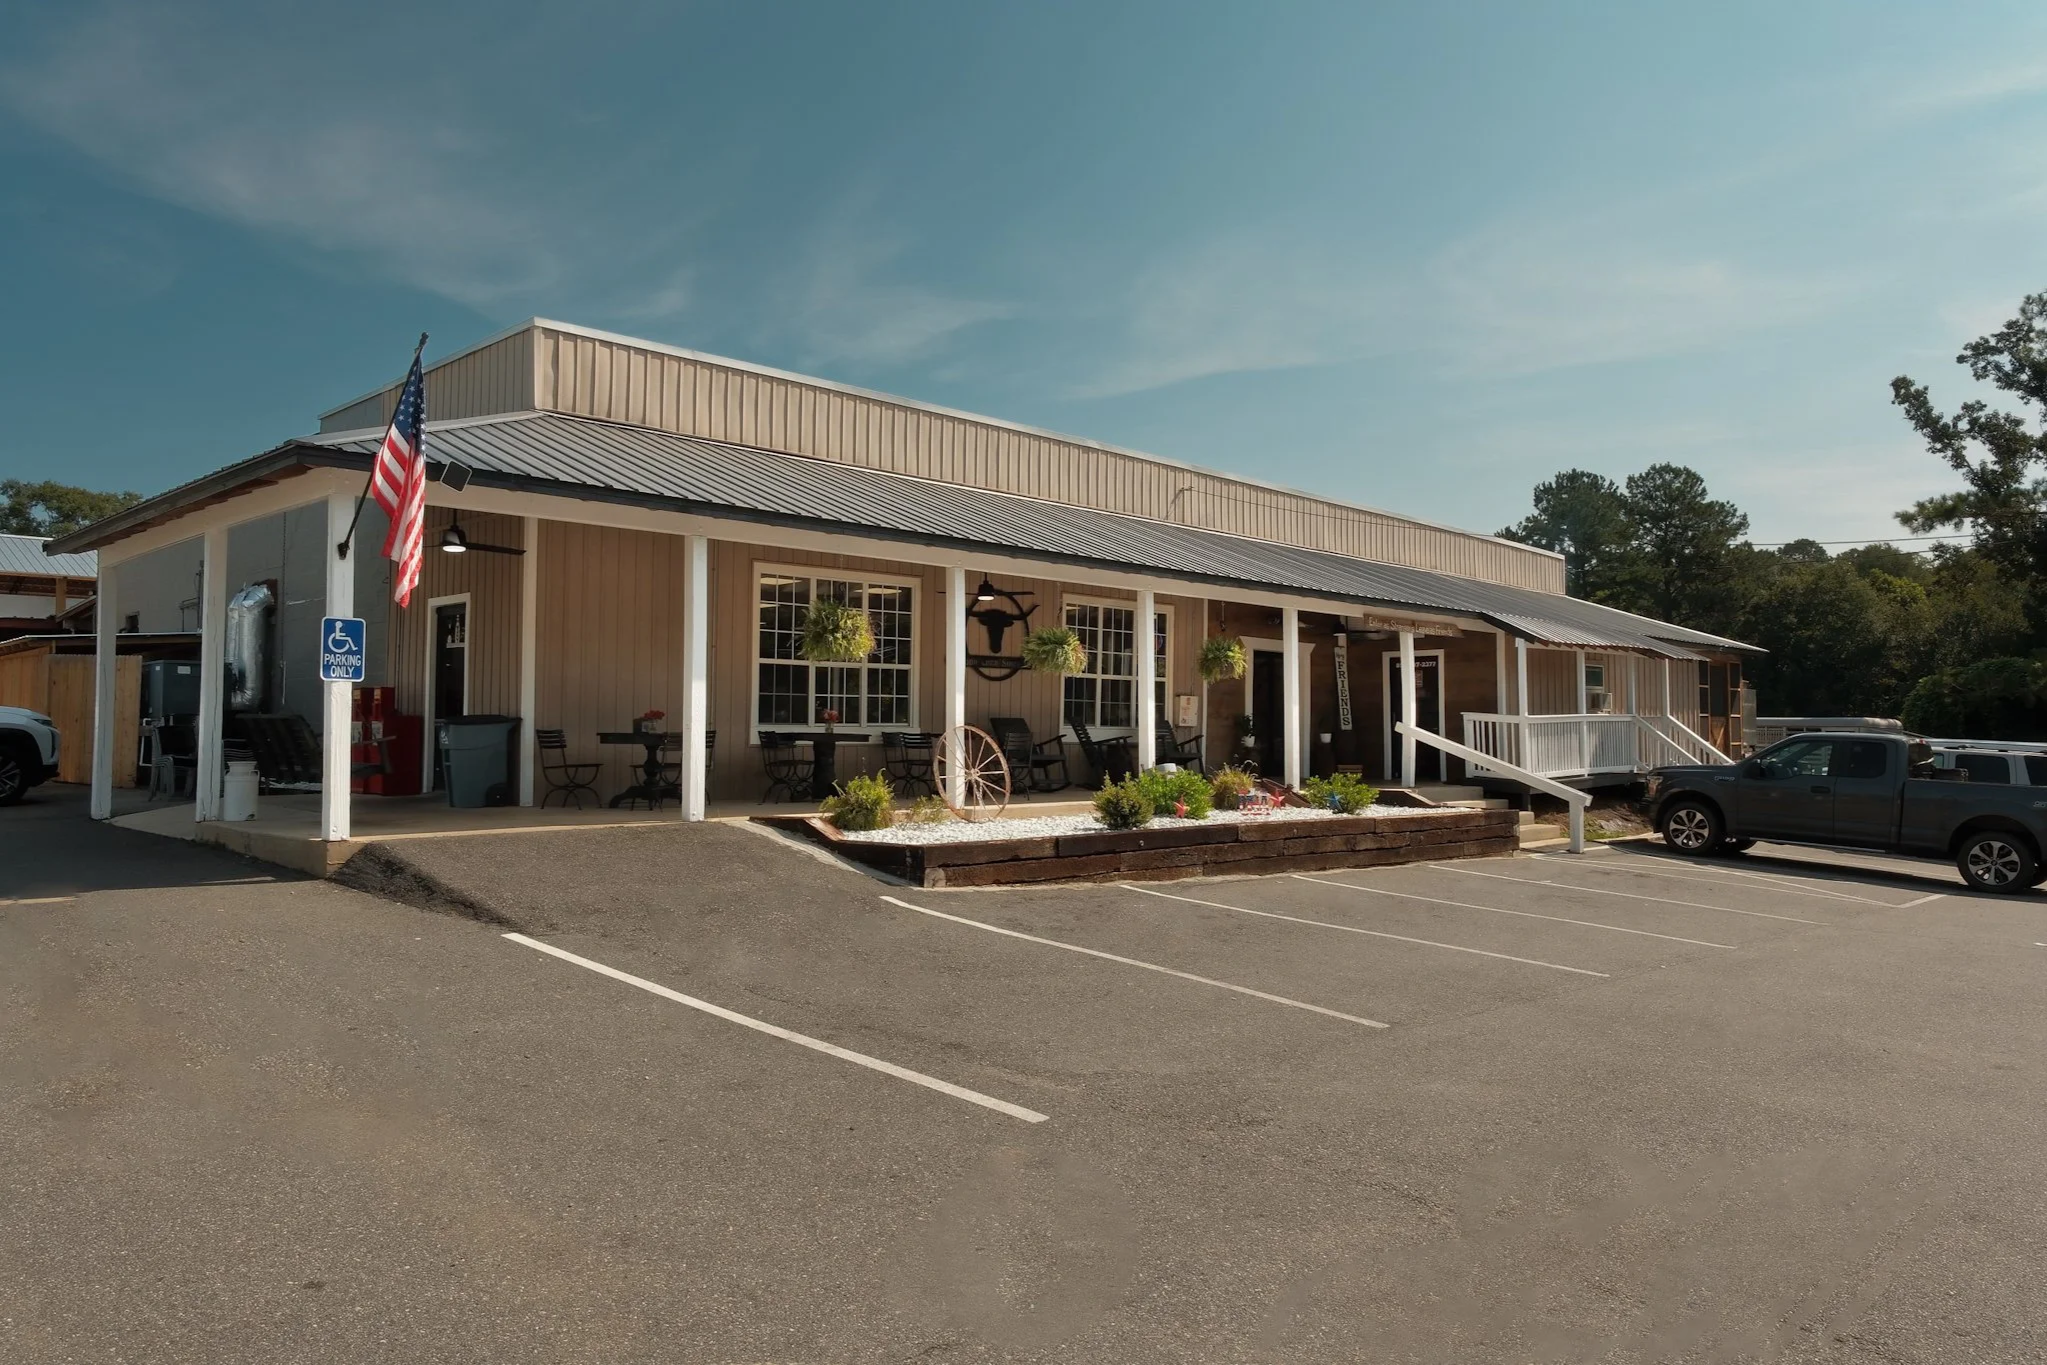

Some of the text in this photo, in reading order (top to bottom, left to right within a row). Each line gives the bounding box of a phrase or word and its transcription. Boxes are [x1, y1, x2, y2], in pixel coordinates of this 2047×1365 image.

[324, 653, 362, 666] PARKING
[330, 665, 355, 678] ONLY
[1337, 661, 1351, 726] FRIENDS
